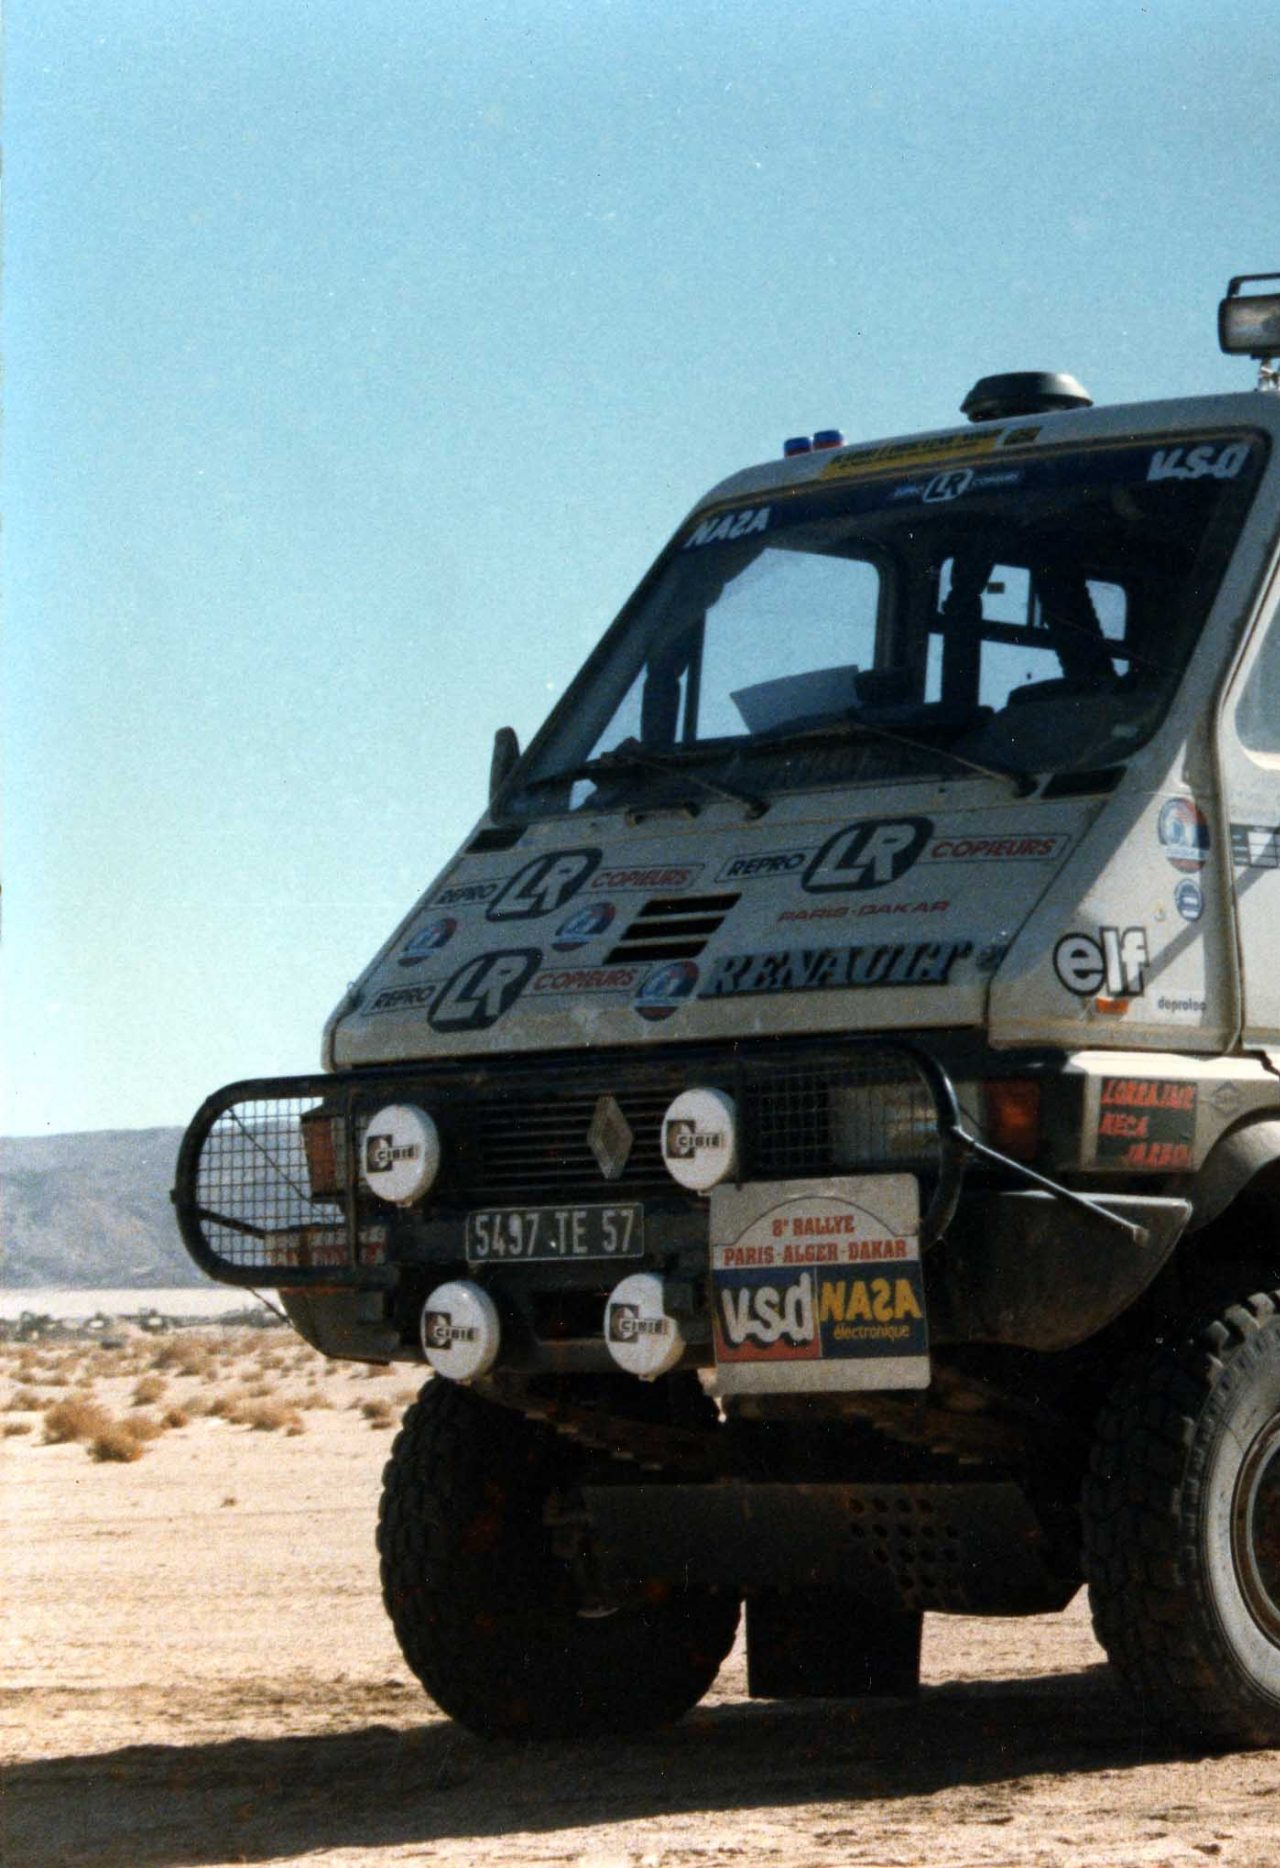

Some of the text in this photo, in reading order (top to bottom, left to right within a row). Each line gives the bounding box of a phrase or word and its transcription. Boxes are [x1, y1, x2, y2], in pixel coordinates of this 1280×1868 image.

[498, 855, 588, 916] LR
[592, 869, 691, 889] COPIEURS
[727, 825, 1056, 886] REPRO LR COPIEURS
[437, 953, 528, 1022] LR
[533, 968, 638, 990] COPIEURS
[708, 941, 972, 995] RENAULT
[1053, 926, 1150, 997] elf
[475, 1208, 634, 1256] 5497 TE 57
[793, 1215, 855, 1237] RALLYE
